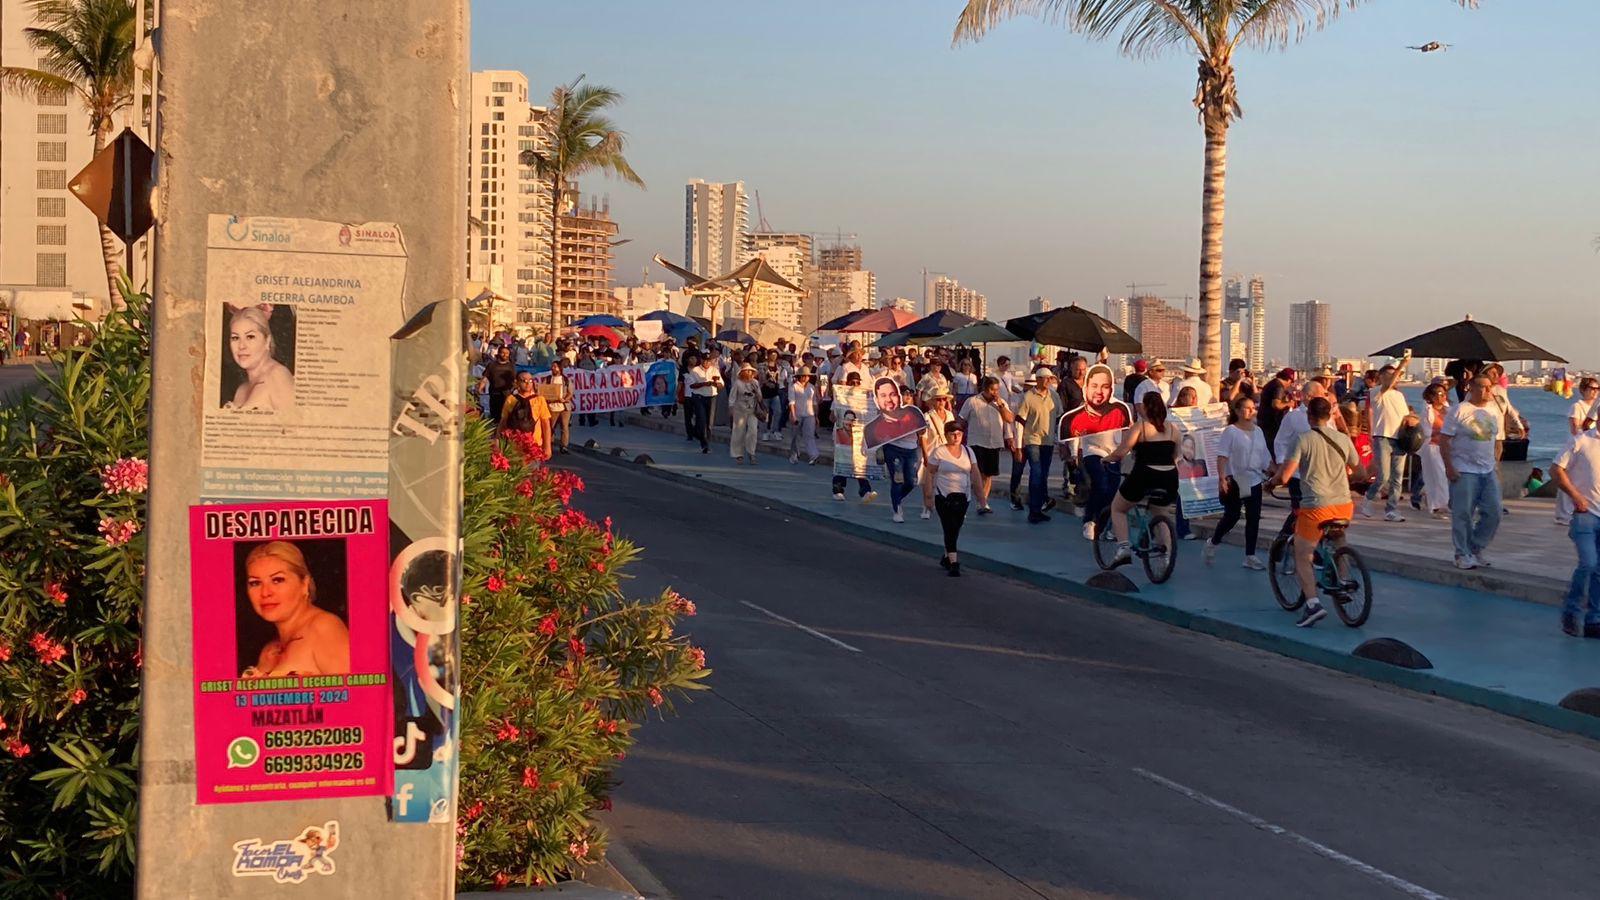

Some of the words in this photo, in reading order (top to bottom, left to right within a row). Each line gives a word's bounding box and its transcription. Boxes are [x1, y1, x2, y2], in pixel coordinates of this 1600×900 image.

[252, 229, 290, 244] Sinaloa
[355, 229, 396, 239] SINALOA
[255, 274, 289, 286] GRISET
[293, 276, 361, 289] ALEJANDRINA
[261, 291, 305, 304] BECERRA
[308, 293, 355, 305] GAMBOA
[611, 369, 643, 388] CASA
[206, 507, 374, 538] DESAPARECIDA
[201, 681, 232, 693] GRISET
[236, 677, 299, 691] ALEJANDRINA
[303, 675, 344, 689] BECERRA
[347, 673, 386, 687] GAMBOA
[236, 695, 248, 707] 13
[252, 692, 315, 706] NOVIEMBRE
[320, 689, 349, 703] 2024
[252, 706, 323, 727] MAZATLÁN
[264, 726, 362, 748] 6693262089
[264, 752, 363, 774] 6699334926
[273, 844, 296, 855] EL
